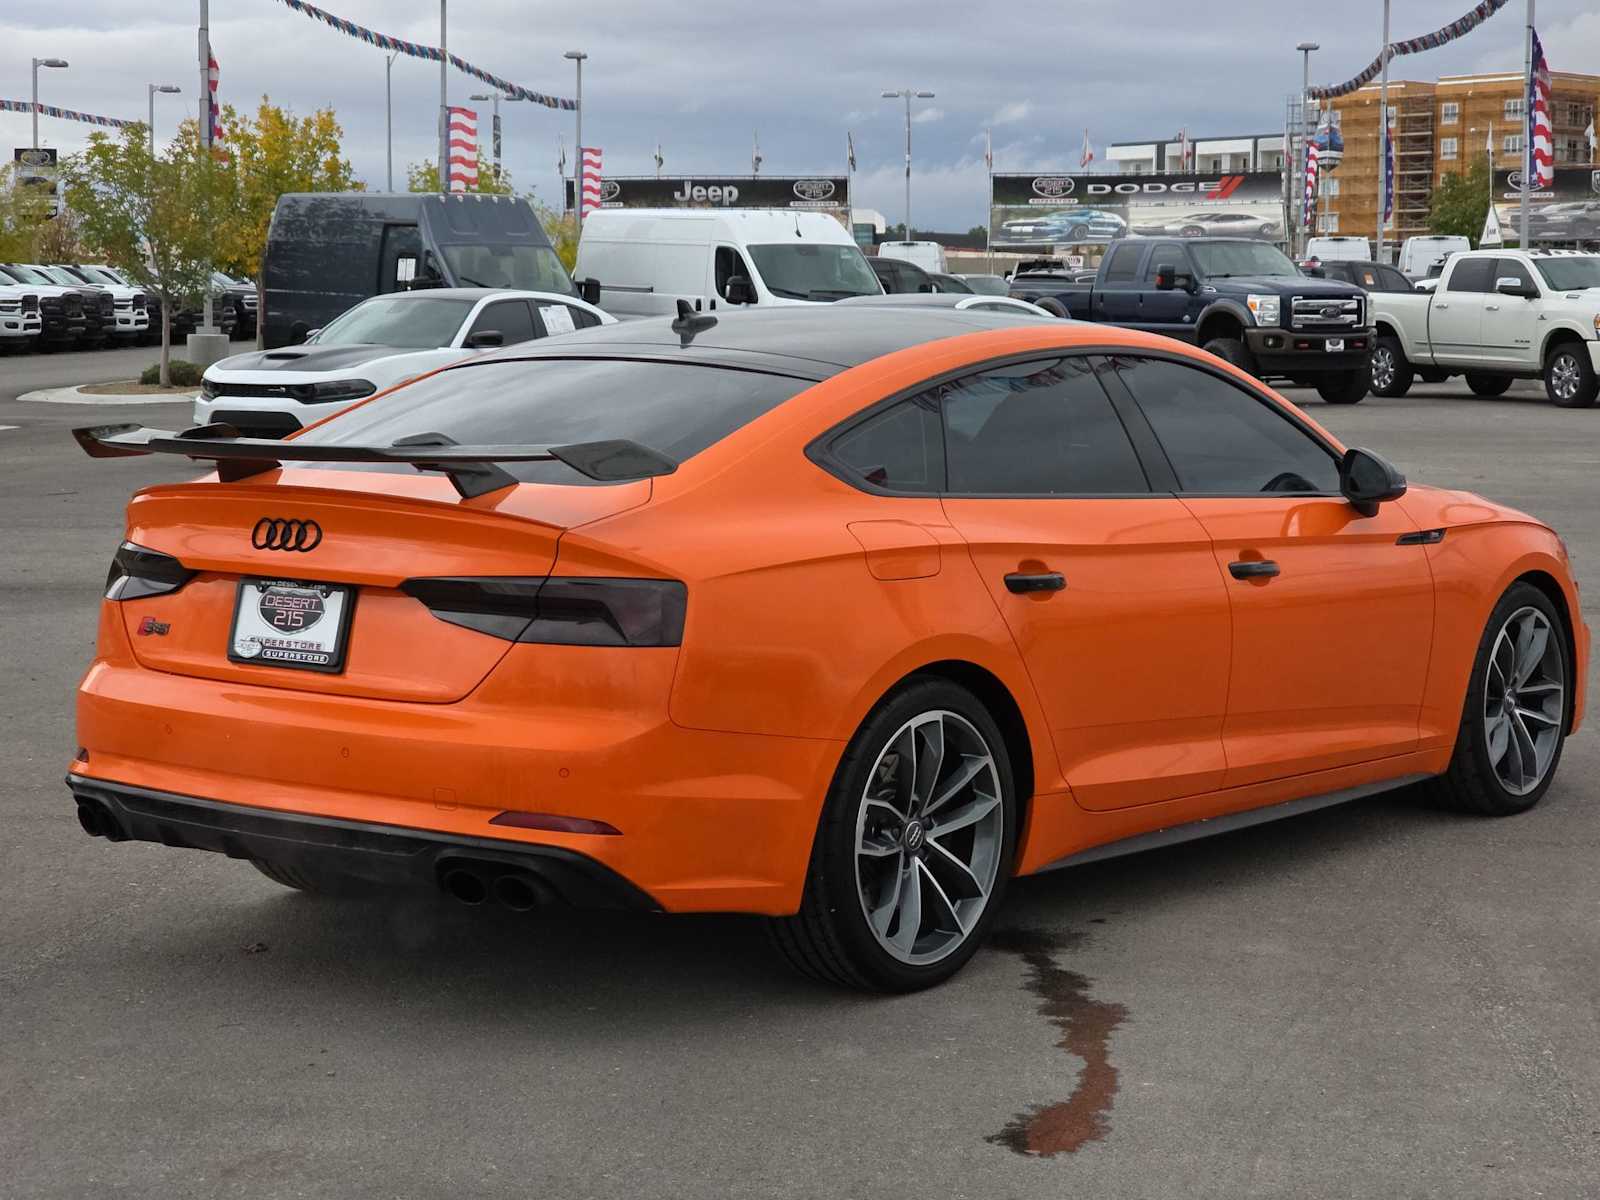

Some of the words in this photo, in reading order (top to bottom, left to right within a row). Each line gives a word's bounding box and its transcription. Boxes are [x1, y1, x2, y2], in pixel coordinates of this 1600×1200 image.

[674, 181, 739, 205] Jeep
[1087, 182, 1221, 195] DODGE
[265, 595, 319, 610] DESERT
[273, 610, 305, 626] 215
[265, 649, 326, 662] SUPERSTORE
